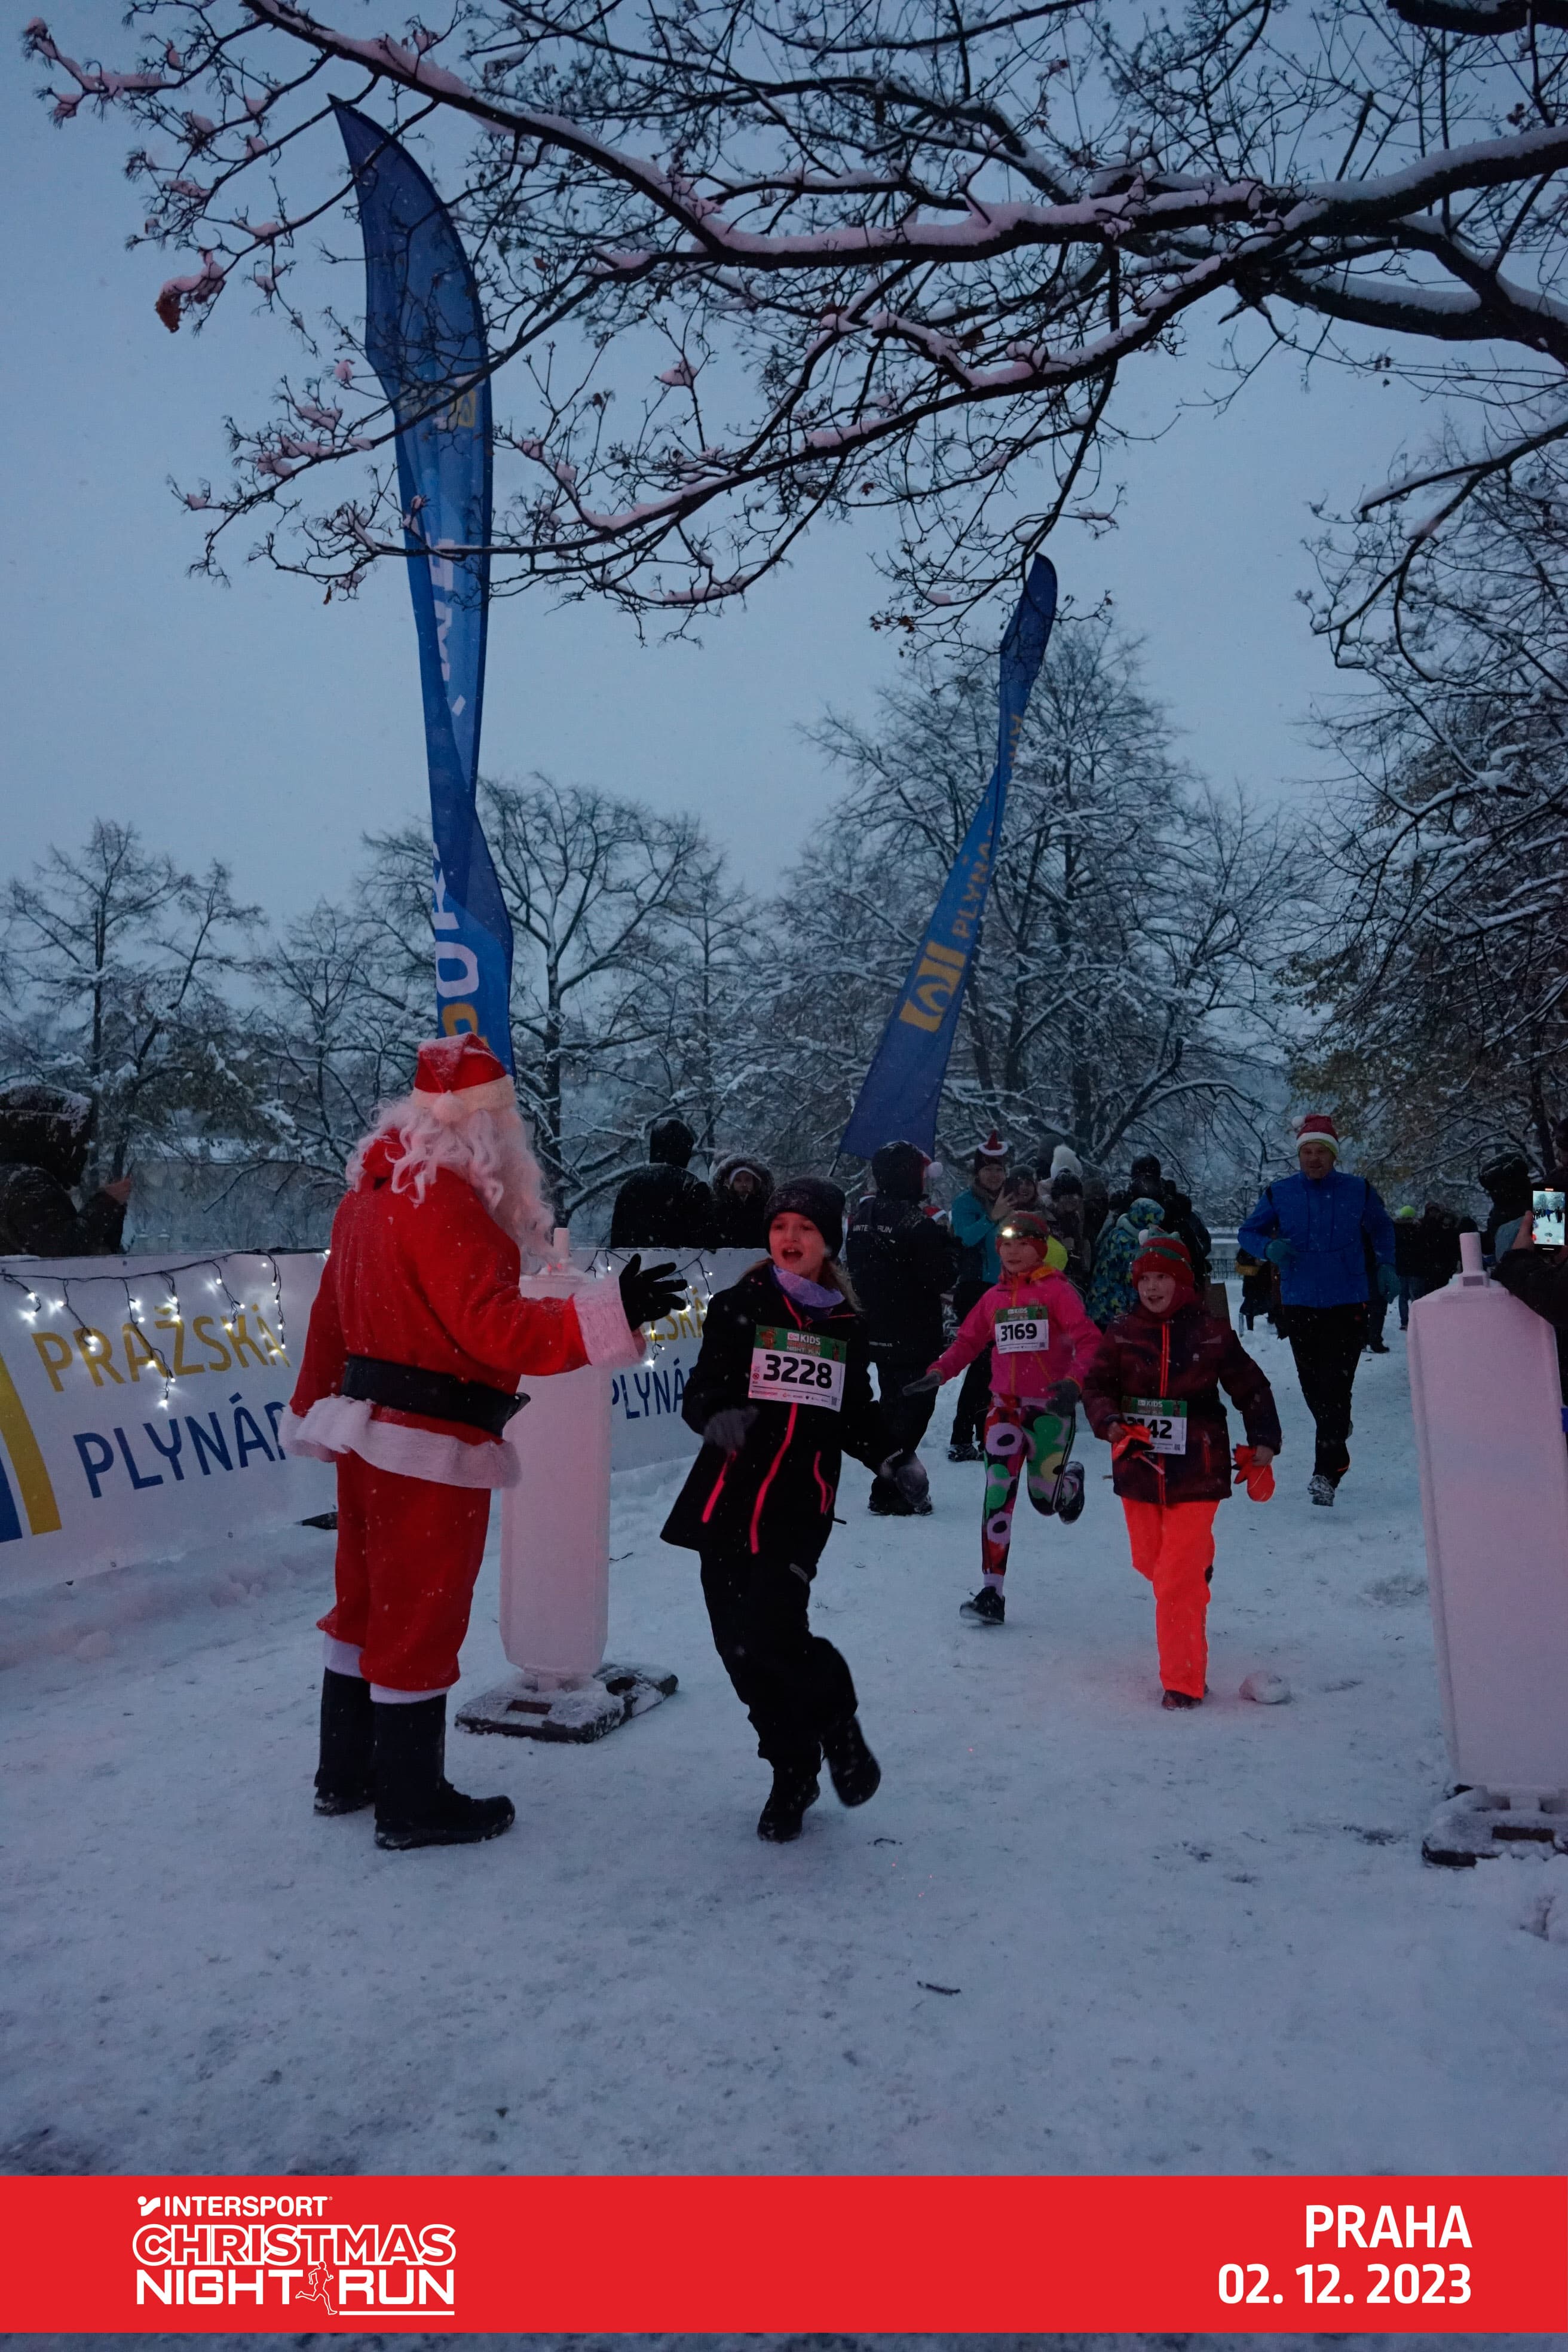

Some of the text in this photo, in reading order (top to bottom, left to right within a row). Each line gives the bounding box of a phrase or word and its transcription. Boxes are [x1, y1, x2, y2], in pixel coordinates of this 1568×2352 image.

[800, 1333, 821, 1346] KIDS
[1000, 1323, 1037, 1342] 3169
[30, 1304, 291, 1392] PRAŽSKÁ
[763, 1354, 832, 1389] 3228
[1146, 1399, 1163, 1408] KIDS
